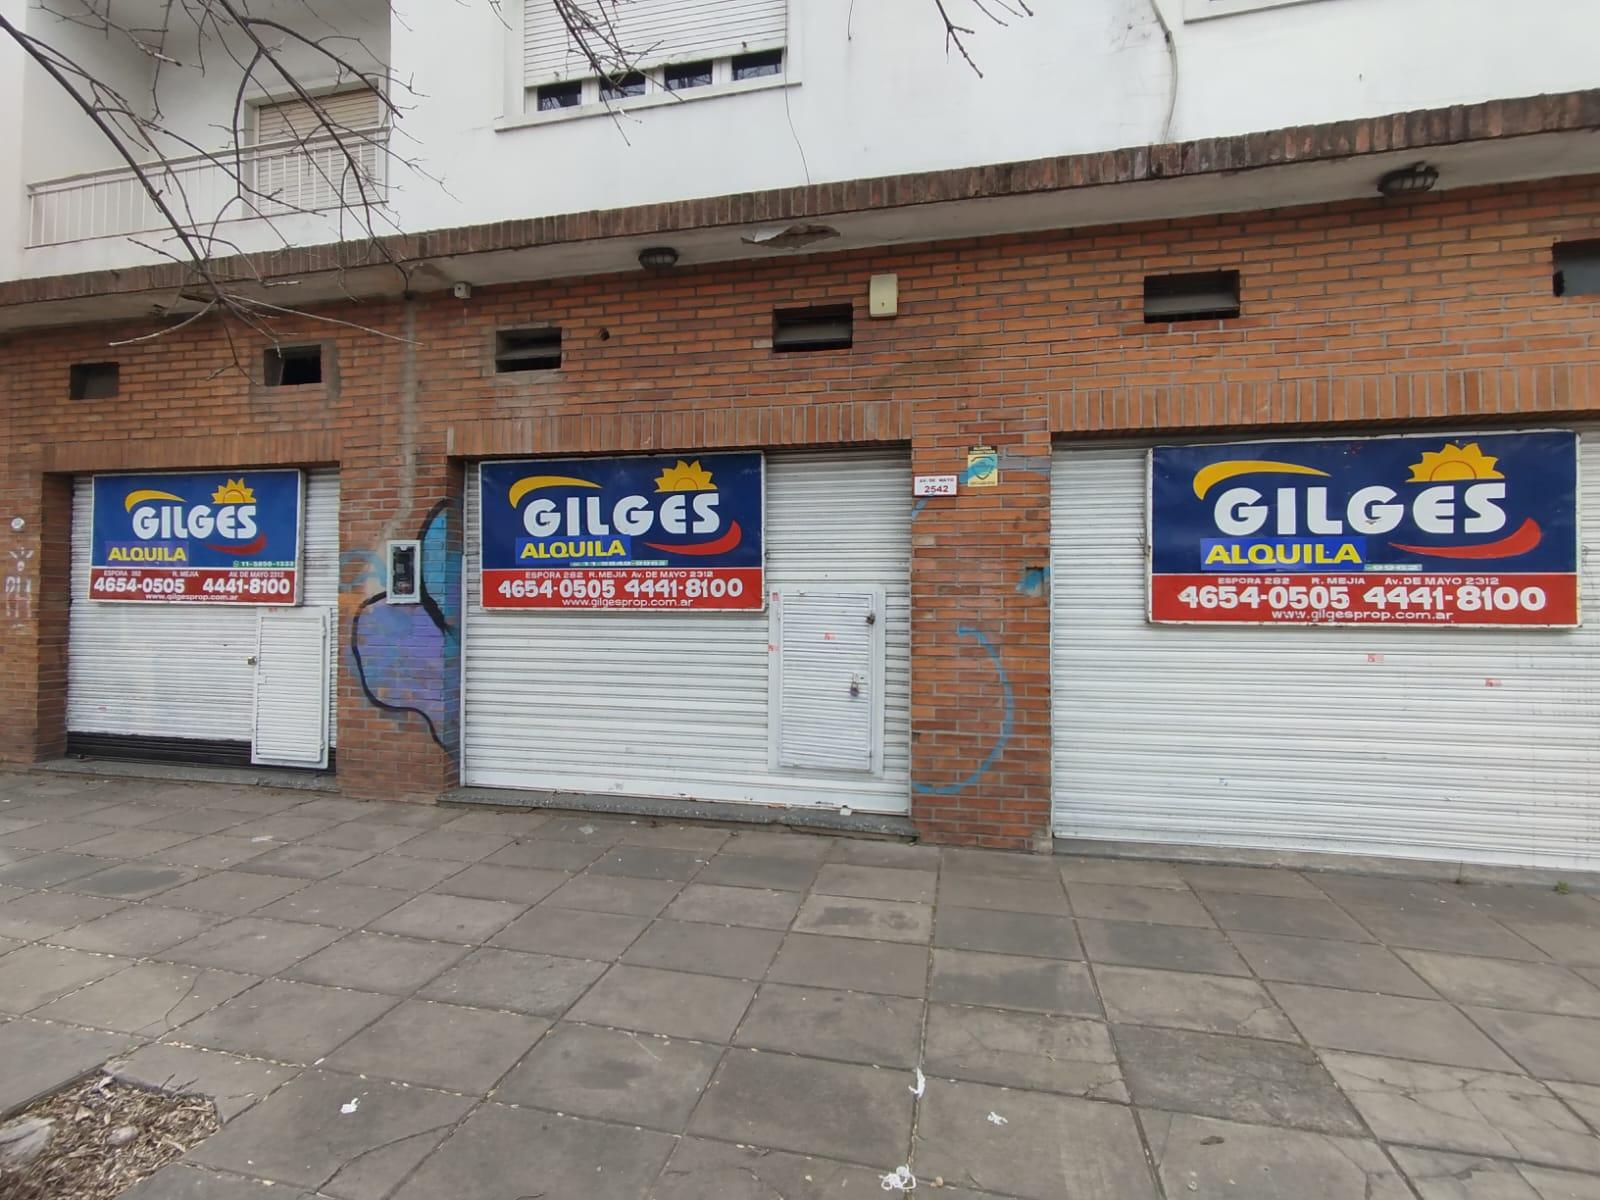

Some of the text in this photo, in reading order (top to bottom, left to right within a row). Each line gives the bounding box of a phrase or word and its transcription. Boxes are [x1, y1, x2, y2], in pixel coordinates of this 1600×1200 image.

[924, 485, 949, 493] 2542
[523, 492, 720, 537] GILGES
[1214, 482, 1507, 536] GILGES
[132, 505, 257, 540] GILGES
[108, 547, 187, 561] ALQUILA
[520, 539, 626, 559] ALQUILA
[1205, 543, 1362, 565] ALQUILA
[525, 571, 561, 579] ESPORA
[1218, 577, 1261, 585] ESPORA
[1264, 577, 1291, 585] 282
[1327, 577, 1366, 585] MEJIA
[1404, 577, 1422, 585] DE
[1425, 577, 1462, 585] MAYO
[1465, 577, 1499, 585] 2312
[94, 577, 290, 594] 4654-0505 4441-8100
[498, 577, 743, 599] 4654-0505 4441-8100
[145, 593, 239, 601] www.gilgesprop.com.ar
[562, 598, 694, 608] www.gilgesprop.com.ar
[1177, 585, 1546, 611] 4654-0505 4441-8100
[1271, 609, 1454, 622] www.gilgesprop.com.ar
